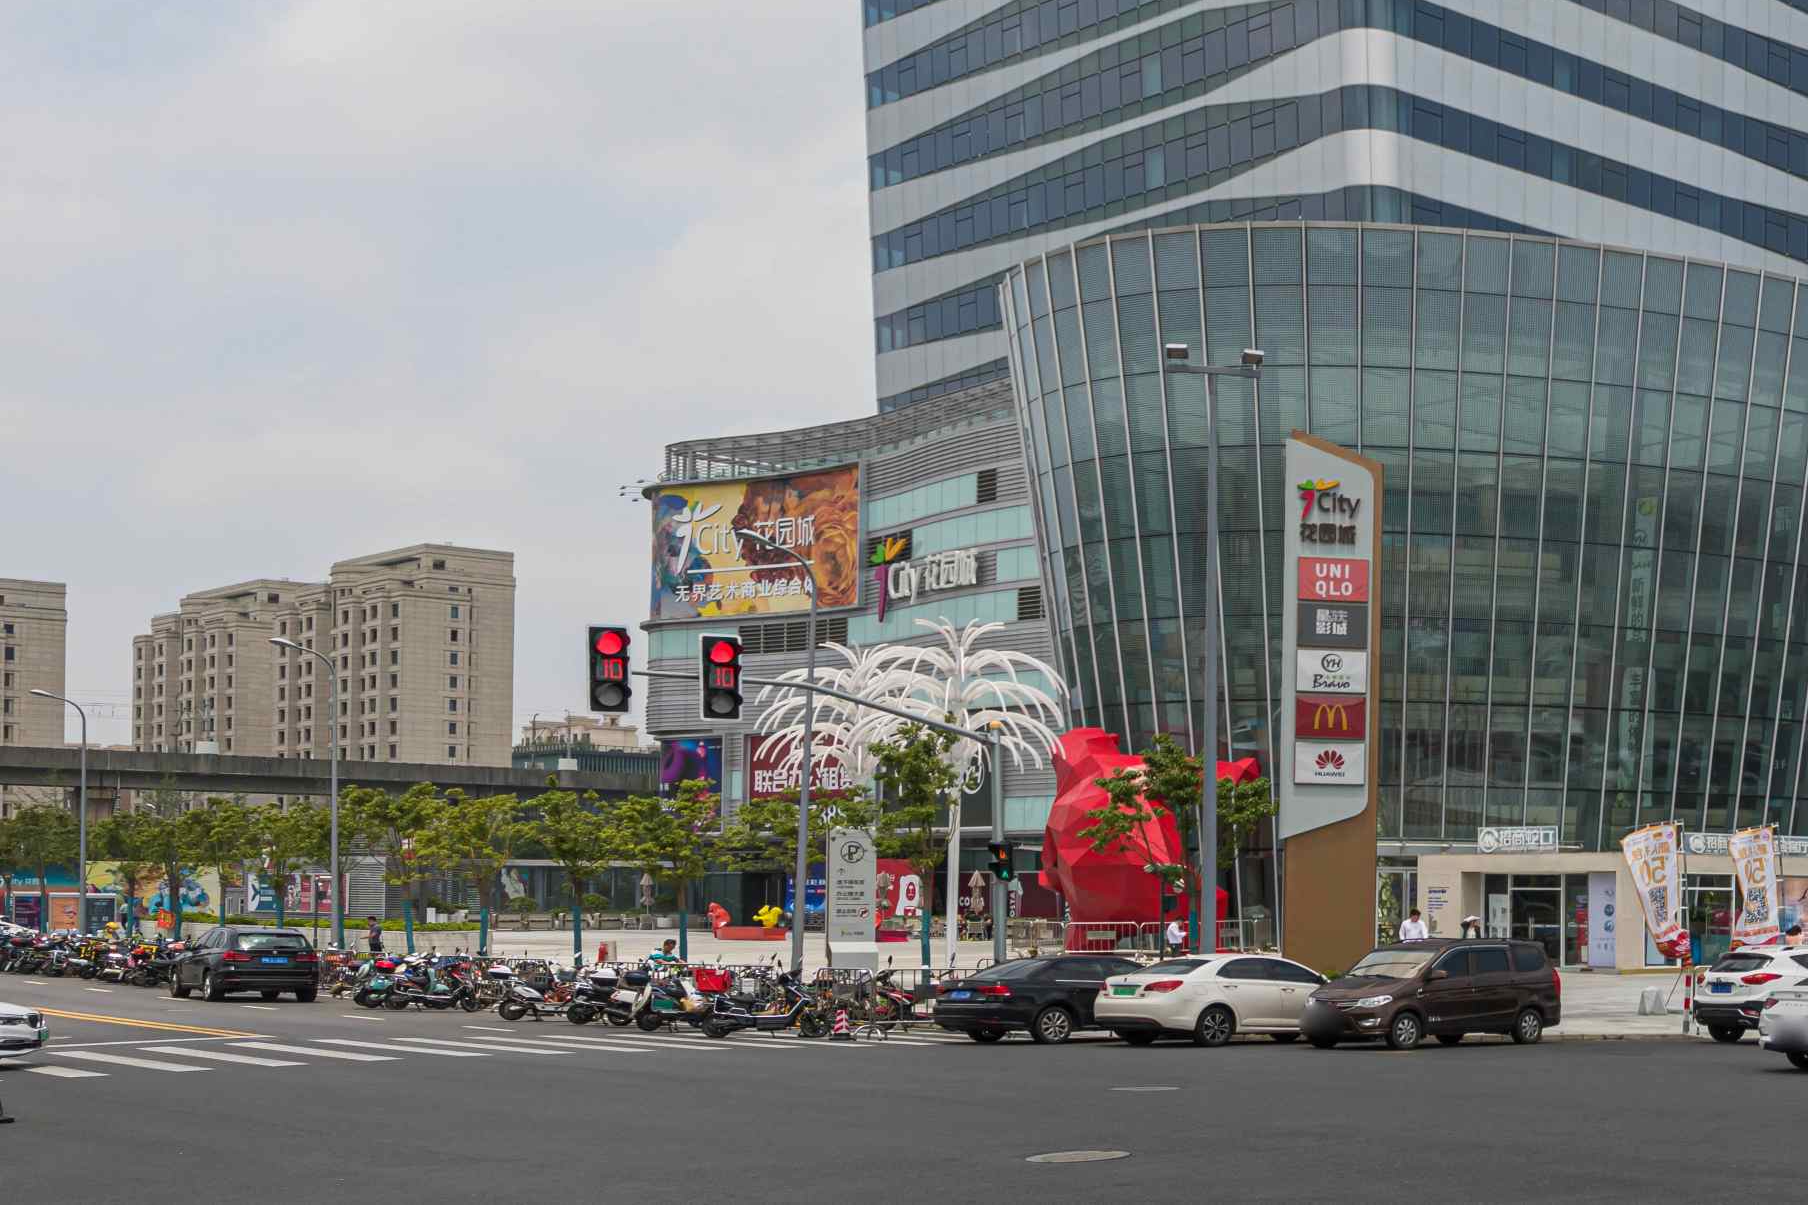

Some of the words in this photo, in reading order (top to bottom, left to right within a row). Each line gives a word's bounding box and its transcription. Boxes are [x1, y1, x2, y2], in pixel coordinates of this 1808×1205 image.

[753, 515, 815, 550] 花园城
[1300, 523, 1357, 545] 花园城
[924, 550, 979, 591] 花园城
[1315, 563, 1350, 578] UNI
[1315, 580, 1353, 598] QLO
[602, 658, 623, 681] 10
[714, 666, 735, 688] 10
[1312, 674, 1351, 690] Bravo
[1501, 829, 1554, 847] 招商蛇口
